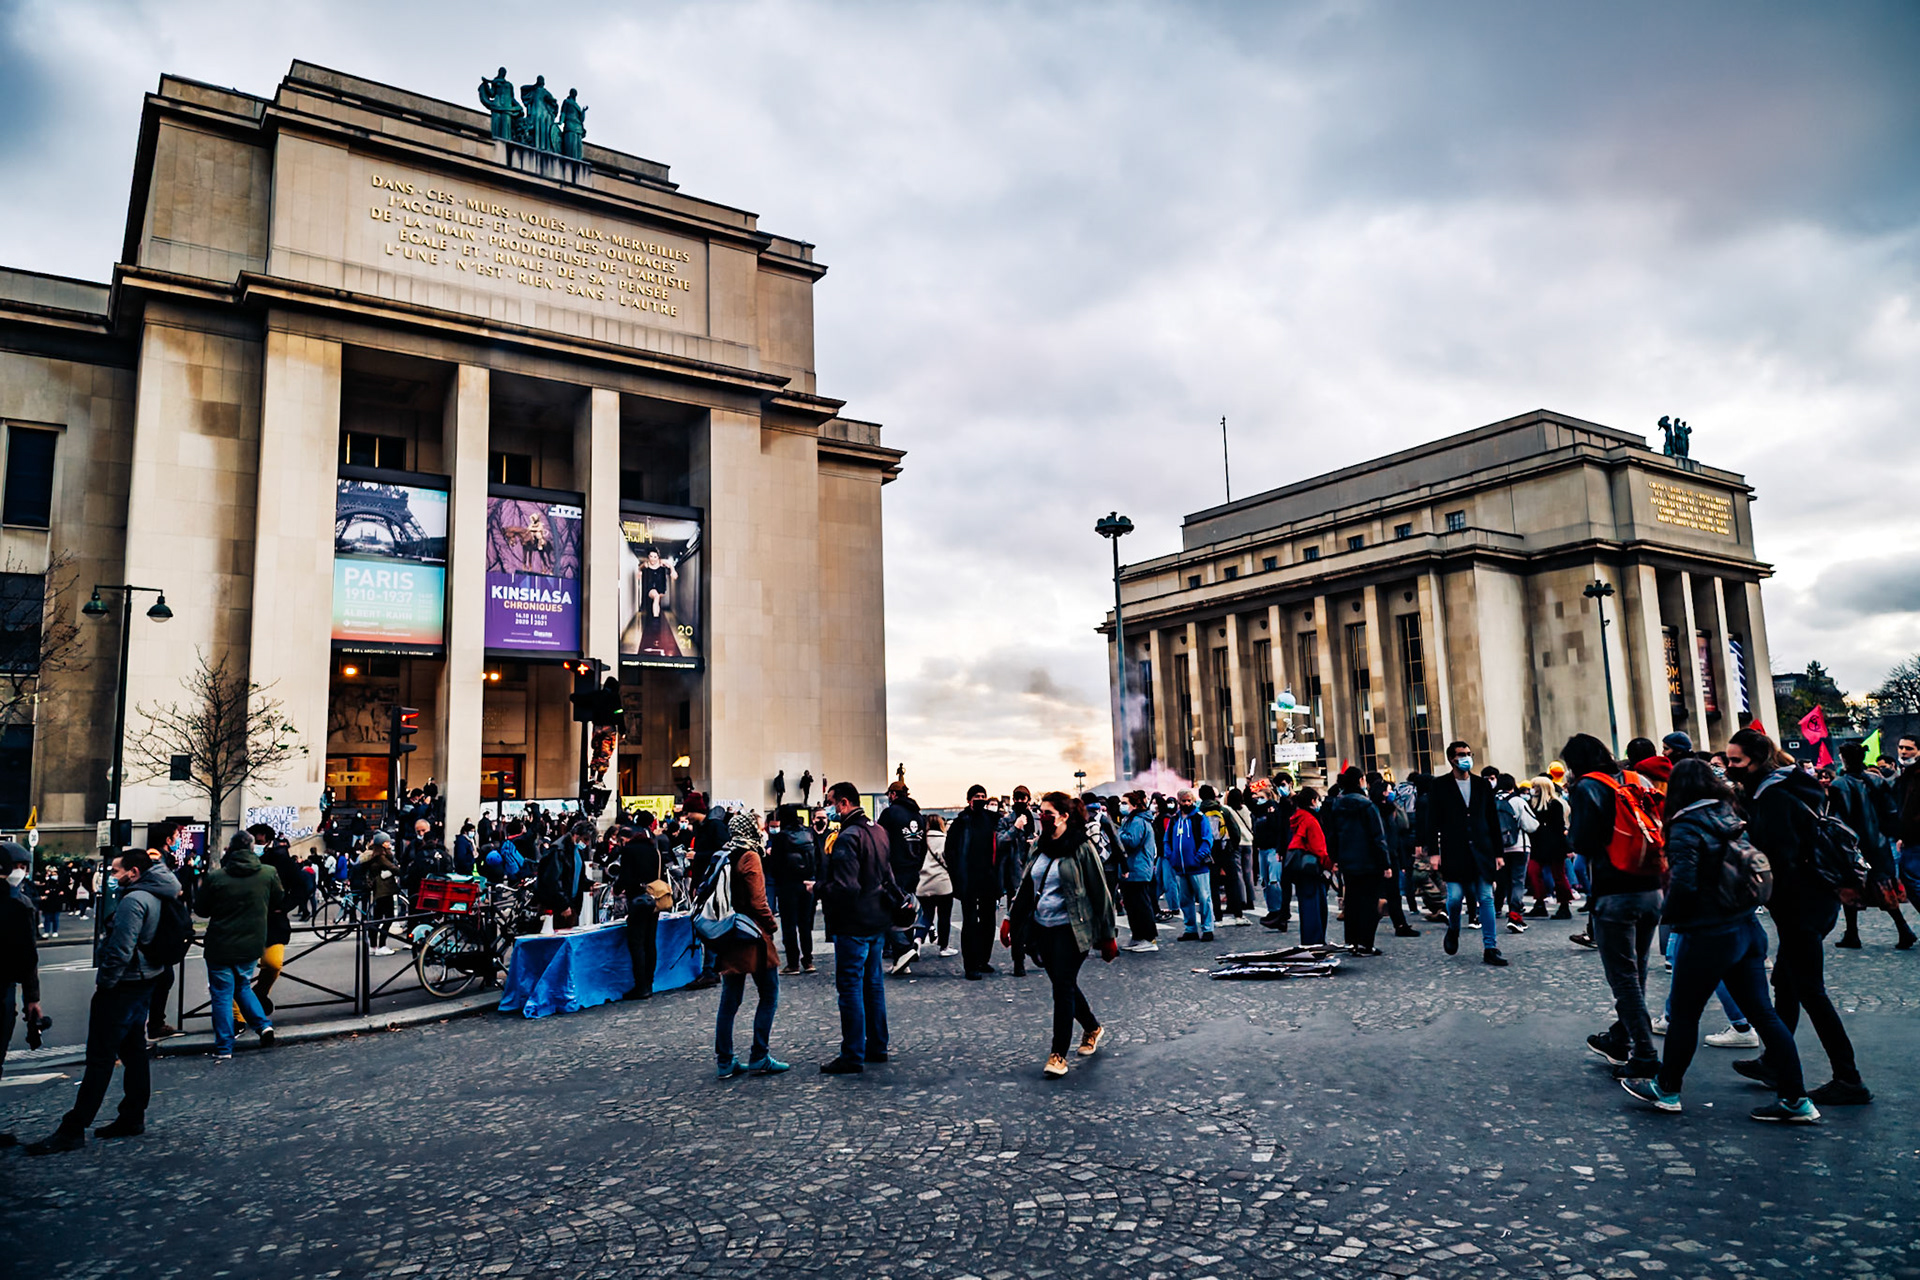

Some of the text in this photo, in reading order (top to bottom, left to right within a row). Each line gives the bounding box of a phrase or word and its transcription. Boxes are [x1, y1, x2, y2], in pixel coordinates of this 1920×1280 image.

[372, 174, 414, 195] DANS
[426, 188, 455, 205] CES
[466, 198, 510, 219] MURS
[576, 226, 603, 242] AUX
[611, 234, 690, 263] MERVEILLES
[371, 206, 690, 291] DE LA MAIN PRODIGIEUSE DE L'ARTISTE
[493, 221, 510, 234] ET
[518, 226, 566, 248] GARDE
[575, 240, 599, 255] LES
[606, 247, 677, 274] OUVRAGES
[385, 242, 677, 317] L'UNE N'EST RIEN SANS L'AUTRE
[462, 244, 480, 258] ET
[494, 251, 544, 272] RIVALE
[557, 265, 575, 280] DE
[588, 273, 605, 286] SA
[618, 279, 669, 301] PENSÉE
[344, 567, 414, 590] PARIS
[344, 587, 413, 604] 1910-1937
[491, 585, 572, 604] KINSHASA
[503, 600, 563, 612] CHRONIQUES
[677, 624, 693, 636] 20
